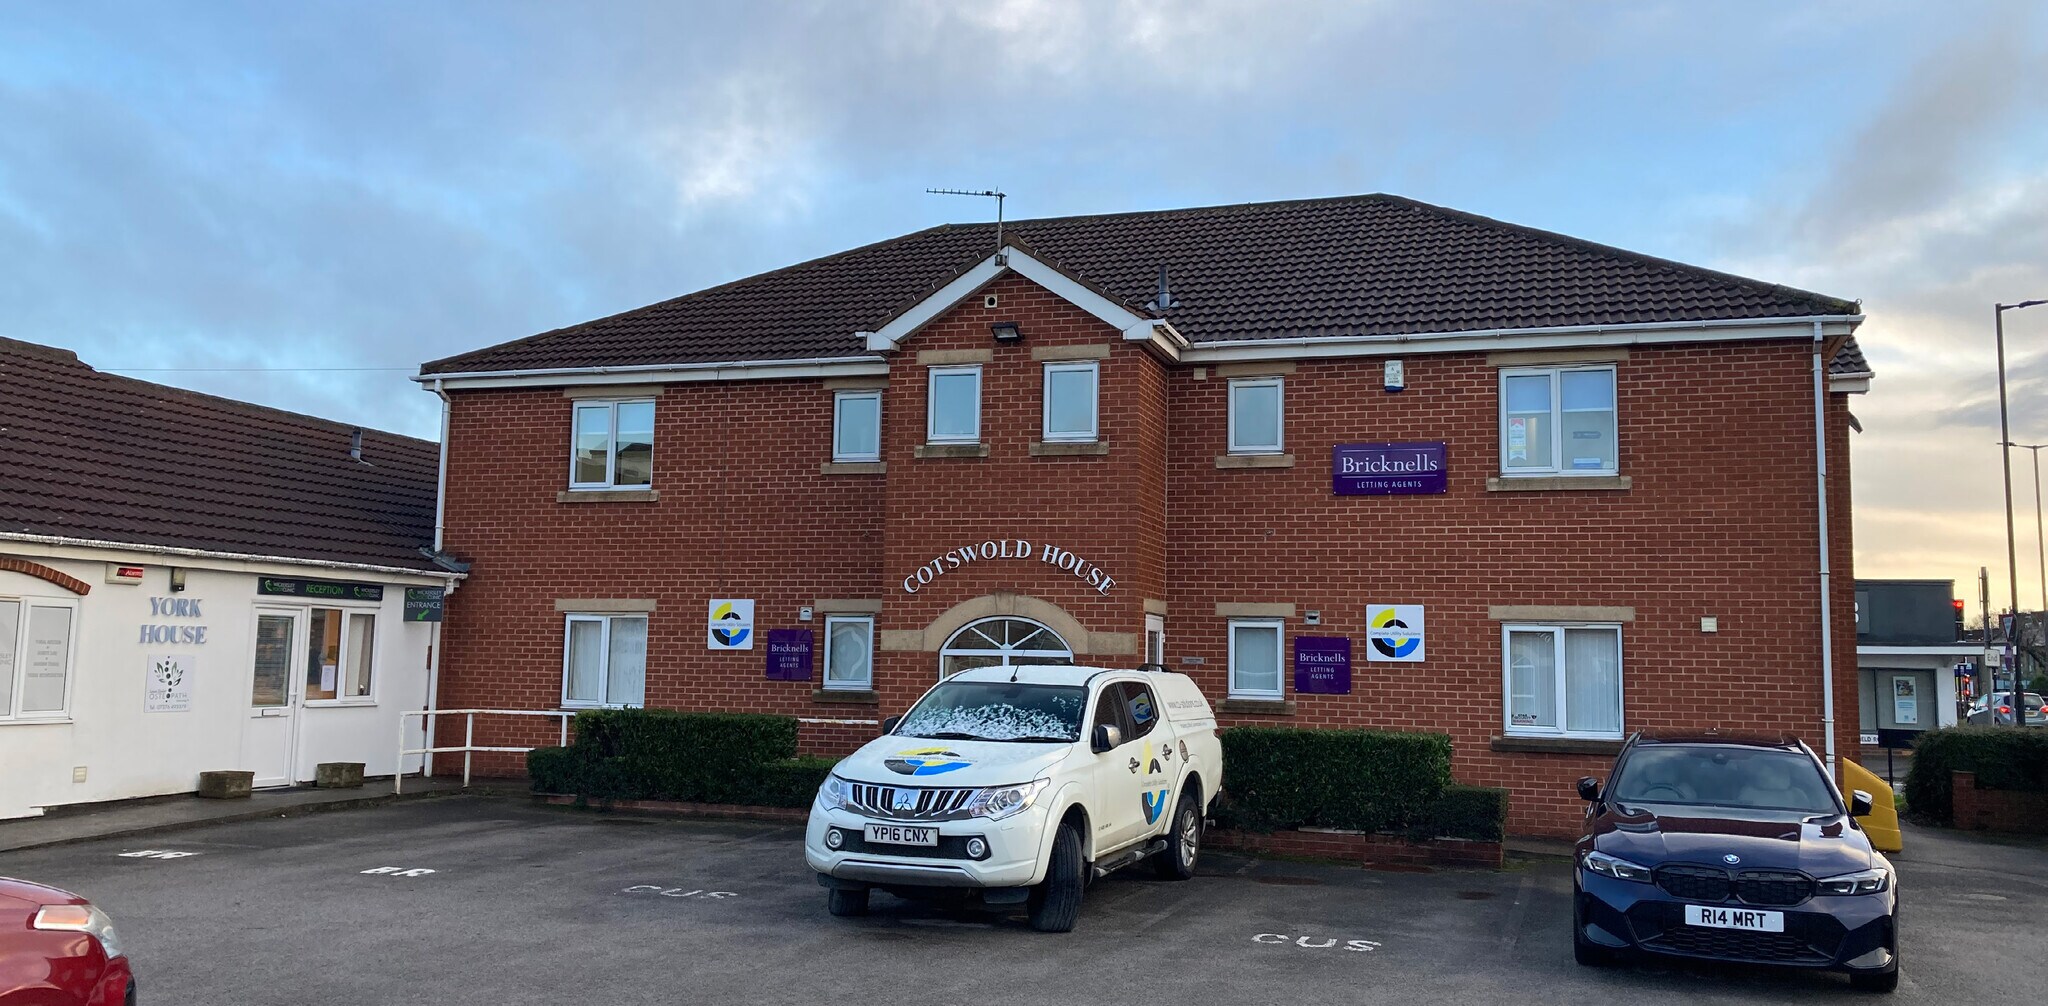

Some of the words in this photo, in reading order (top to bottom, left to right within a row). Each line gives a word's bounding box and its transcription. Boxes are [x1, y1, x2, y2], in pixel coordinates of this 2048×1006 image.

[1342, 453, 1438, 473] Bricknells
[1392, 480, 1422, 488] AGENTS
[903, 539, 1032, 594] COTSWOLD
[1041, 543, 1117, 597] HOUSE
[305, 584, 344, 595] RECEPTION
[149, 596, 203, 618] YORK
[406, 601, 441, 609] ENTRANCE
[138, 624, 208, 645] HOUSE
[771, 643, 809, 653] Bricknells
[1300, 652, 1346, 663] Bricknells
[1987, 652, 1998, 663] End
[872, 826, 901, 841] YP16
[903, 828, 929, 843] CNX
[1701, 908, 1728, 925] R14
[1733, 911, 1767, 929] MRT
[1251, 933, 1382, 952] CUS
